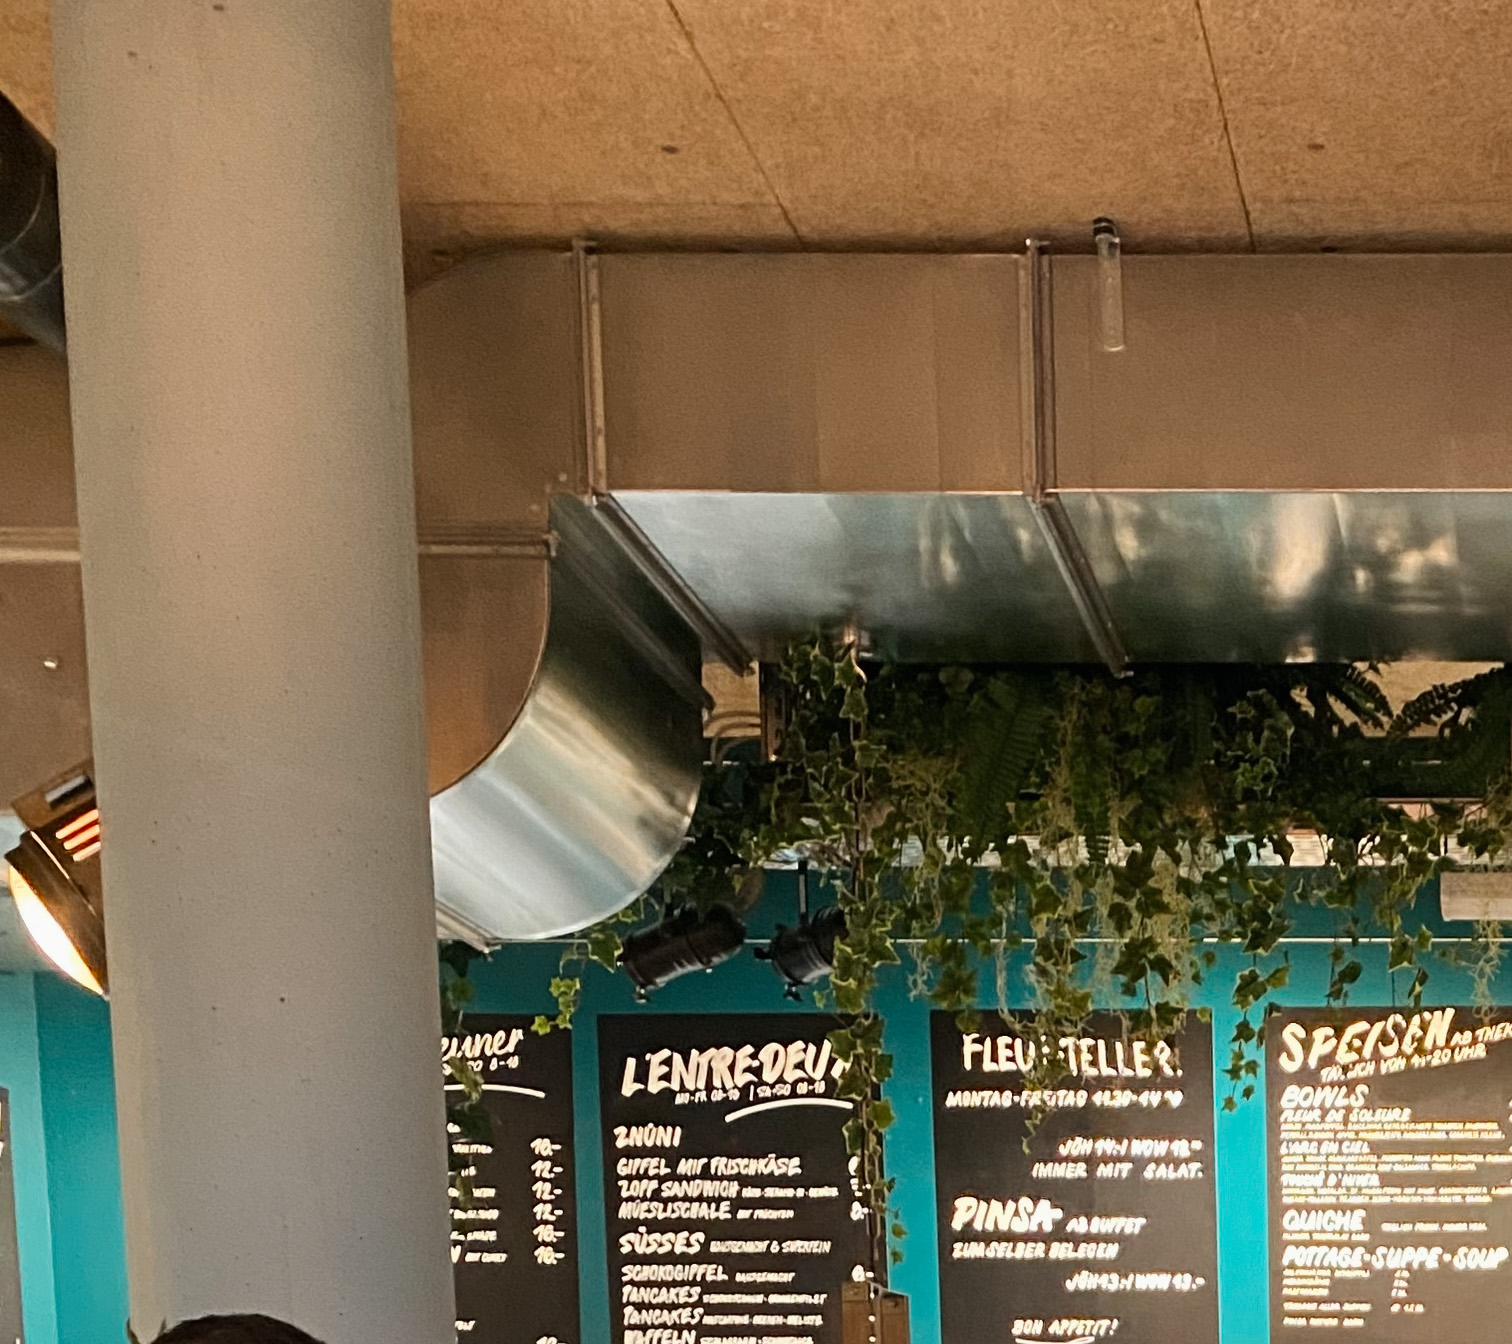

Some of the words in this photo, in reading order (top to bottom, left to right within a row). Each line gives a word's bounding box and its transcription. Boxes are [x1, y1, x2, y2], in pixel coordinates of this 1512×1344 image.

[1279, 1008, 1456, 1073] SPEISEN
[1454, 1043, 1487, 1063] UHR
[1280, 1084, 1370, 1108] BOWLS
[617, 1158, 671, 1175] GIPFEL
[677, 1158, 707, 1175] MIT
[711, 1154, 801, 1175] FRISCHKÄSE
[1032, 1162, 1087, 1178] IMMER
[1097, 1162, 1133, 1178] MIT
[618, 1180, 658, 1197] ZOPF
[661, 1180, 739, 1198] SANDWICH
[1283, 1209, 1366, 1232] QUICHE
[619, 1226, 704, 1254] SÜSSES
[622, 1264, 728, 1281] SCHOKOGIPFEL
[623, 1285, 701, 1303] PANCAKES
[624, 1306, 703, 1325] PANCAKES
[1012, 1319, 1043, 1335] BON
